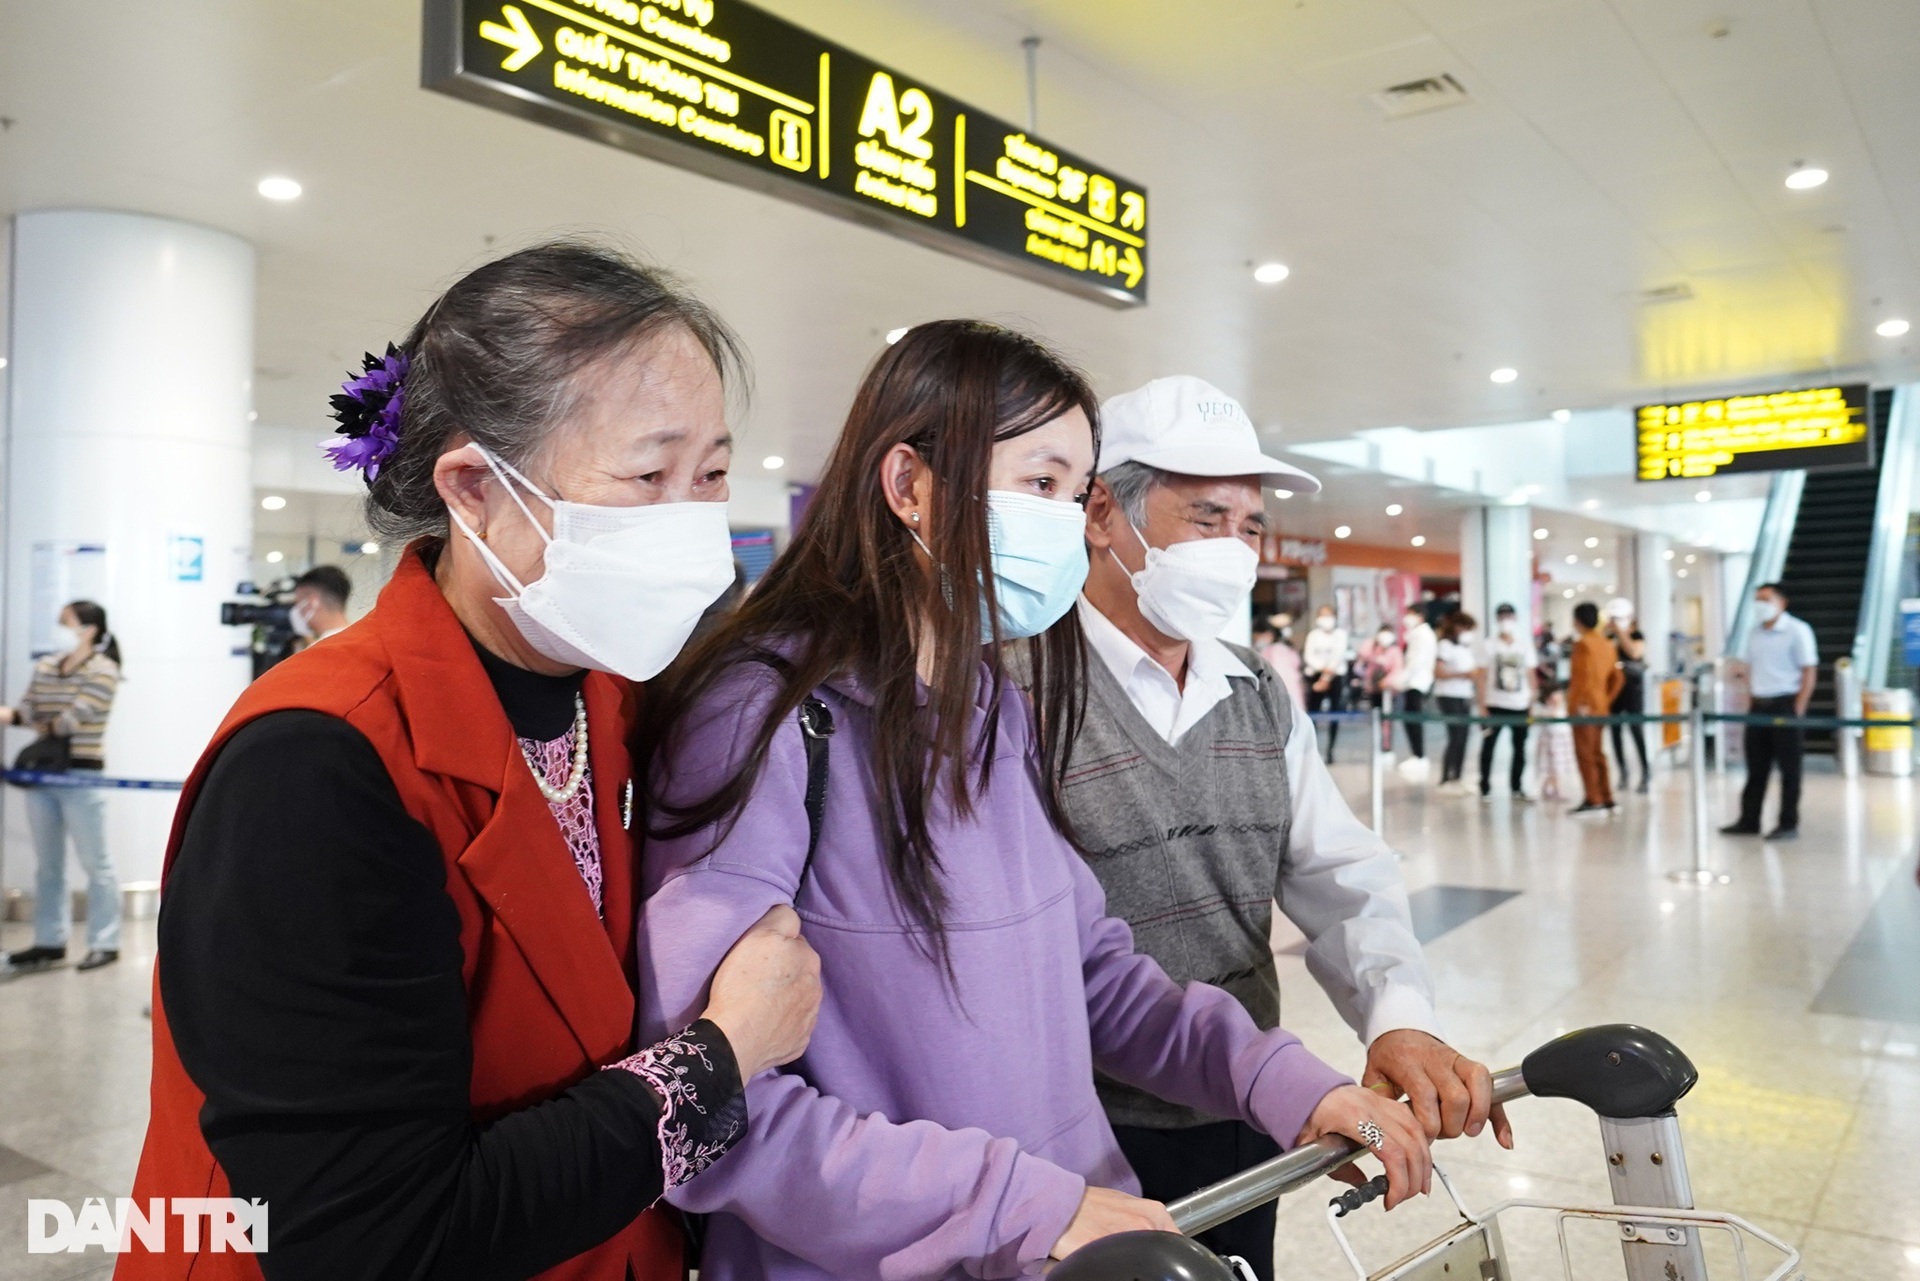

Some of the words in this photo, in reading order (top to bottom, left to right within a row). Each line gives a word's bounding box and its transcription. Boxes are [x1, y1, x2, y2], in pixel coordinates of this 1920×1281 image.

[554, 60, 677, 126] Information
[703, 82, 739, 117] TIN
[858, 71, 934, 161] A2
[1089, 239, 1117, 277] A1
